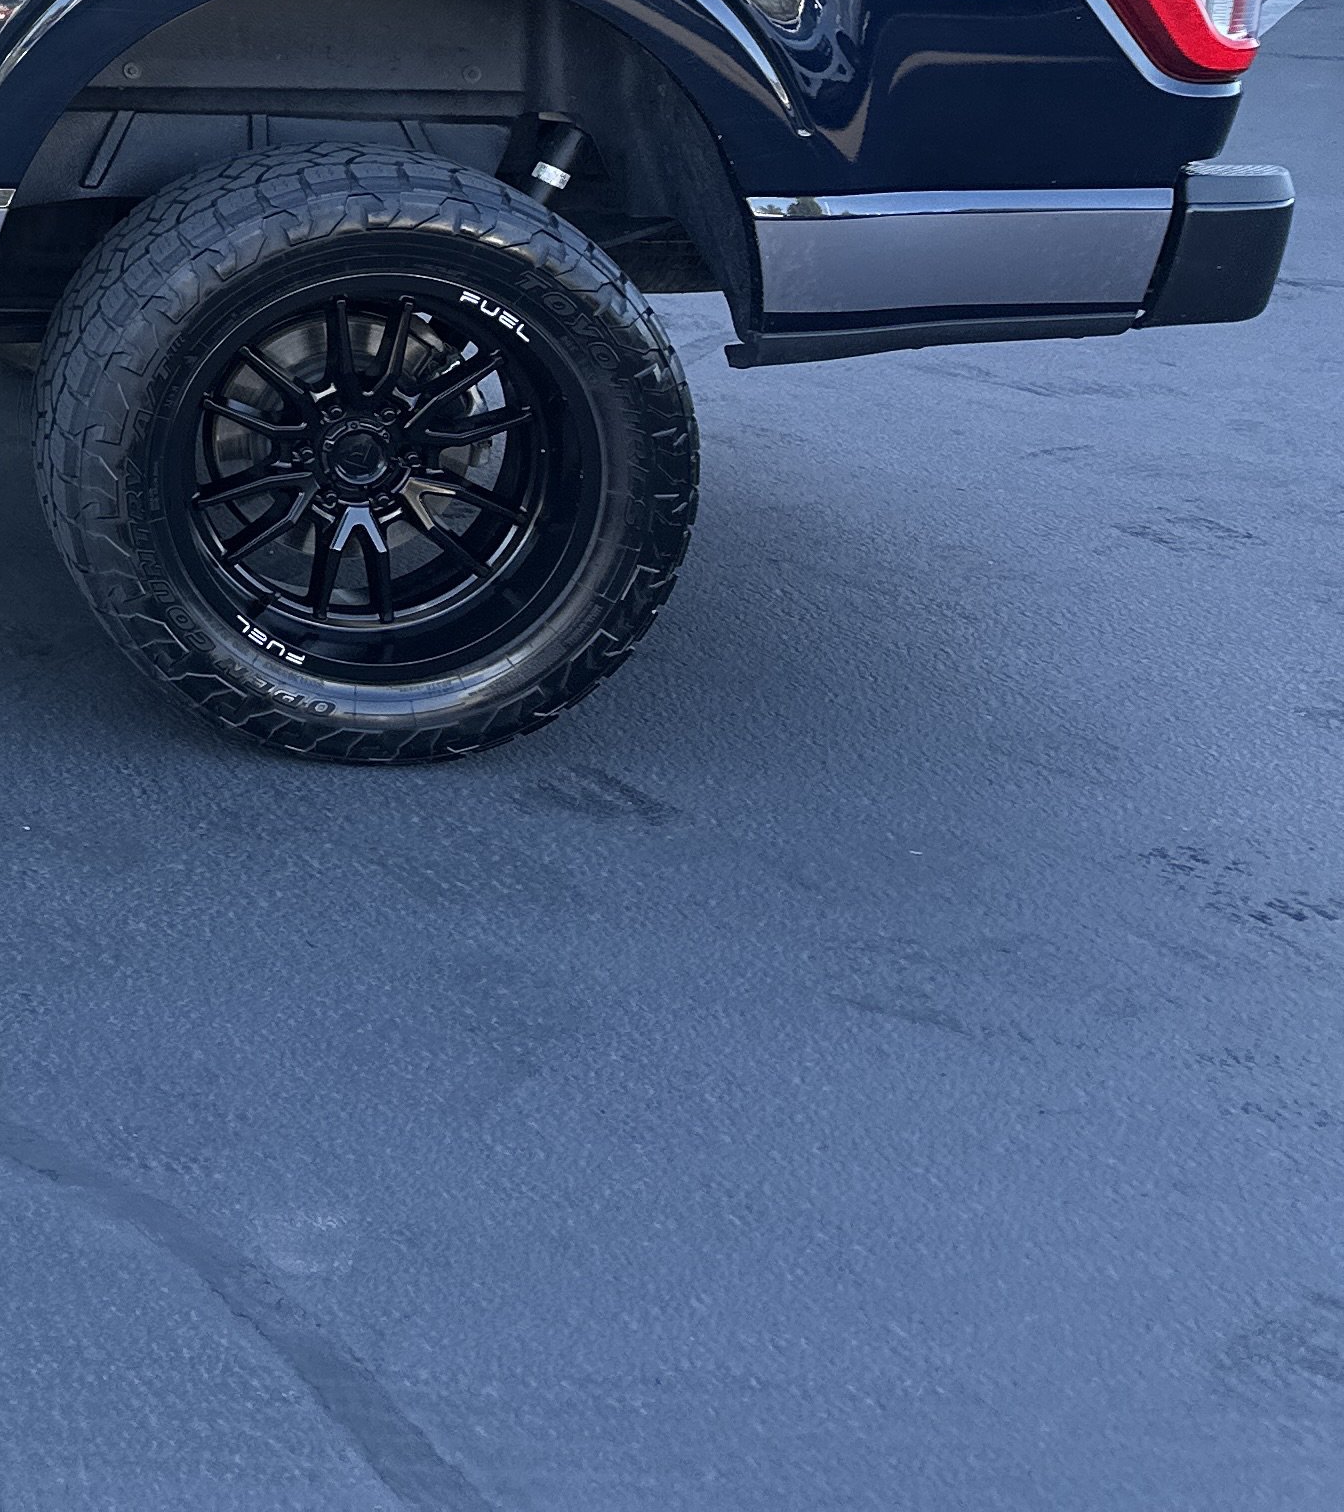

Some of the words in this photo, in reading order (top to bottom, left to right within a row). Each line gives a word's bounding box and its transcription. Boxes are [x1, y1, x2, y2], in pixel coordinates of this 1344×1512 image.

[459, 290, 530, 343] FUEL
[514, 270, 622, 370] TOYO
[125, 455, 216, 653] COUNTRY
[237, 615, 306, 666] FUEL
